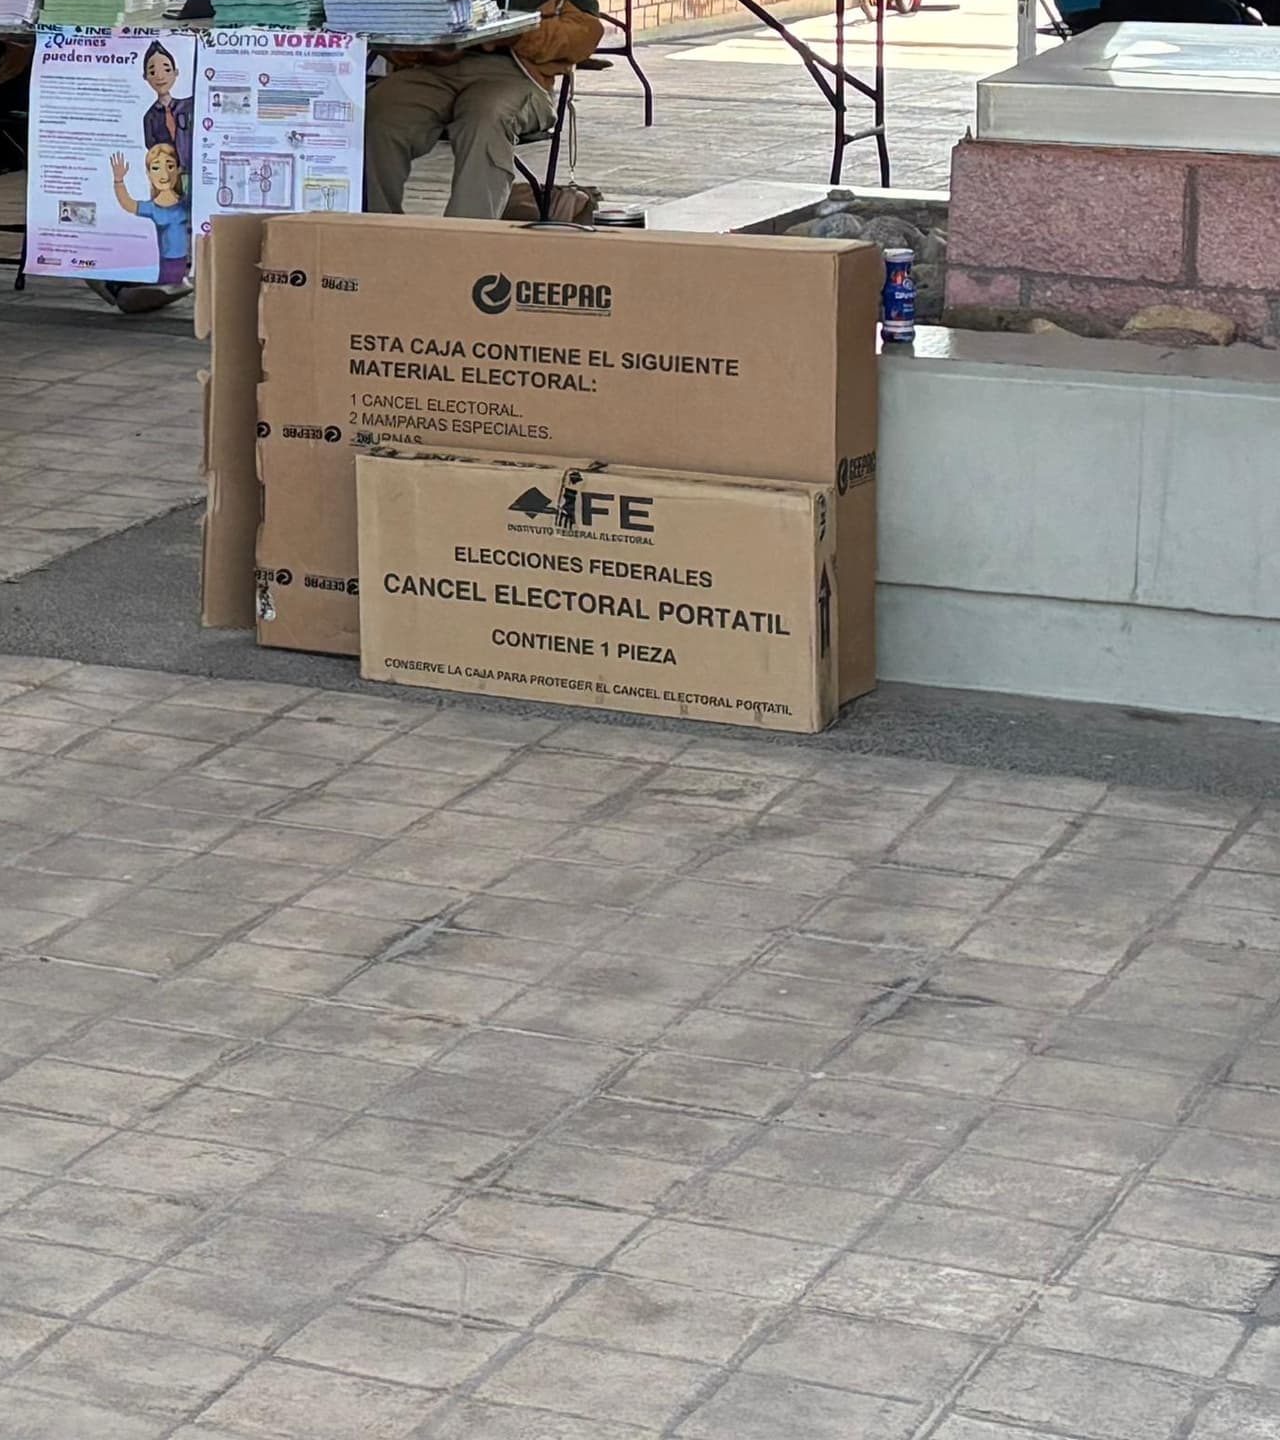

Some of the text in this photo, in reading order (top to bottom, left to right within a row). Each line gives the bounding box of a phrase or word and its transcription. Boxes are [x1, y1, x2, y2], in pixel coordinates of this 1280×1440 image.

[273, 33, 353, 48] VOTAR?
[42, 49, 138, 65] pueden votar?
[516, 280, 612, 309] CEEPAC
[350, 334, 739, 377] ESTA CAJA CONTIENE EL SIGUIENTE
[349, 359, 597, 393] MATERIAL ELECTORAL:
[351, 394, 523, 418] 1 CANCEL ELECTORAL.
[349, 412, 553, 441] 2 MAMPARAS ESPECIALES.
[507, 523, 554, 536] INSTITUTO
[555, 528, 598, 540] FEDERAL
[454, 546, 713, 588] ELECCIONES FEDERALES
[383, 572, 791, 636] CANCEL ELECTORAL PORTATIL
[492, 629, 678, 666] CONTIENE 1 PIEZA
[384, 657, 445, 674] CONSERVE
[447, 665, 463, 676] LA
[465, 667, 495, 679] CAJA
[497, 671, 528, 684] PARA
[530, 674, 593, 692] PROTEGER
[596, 682, 610, 694] EL
[613, 684, 661, 700] CANCEL
[663, 691, 733, 709] ELECTORAL
